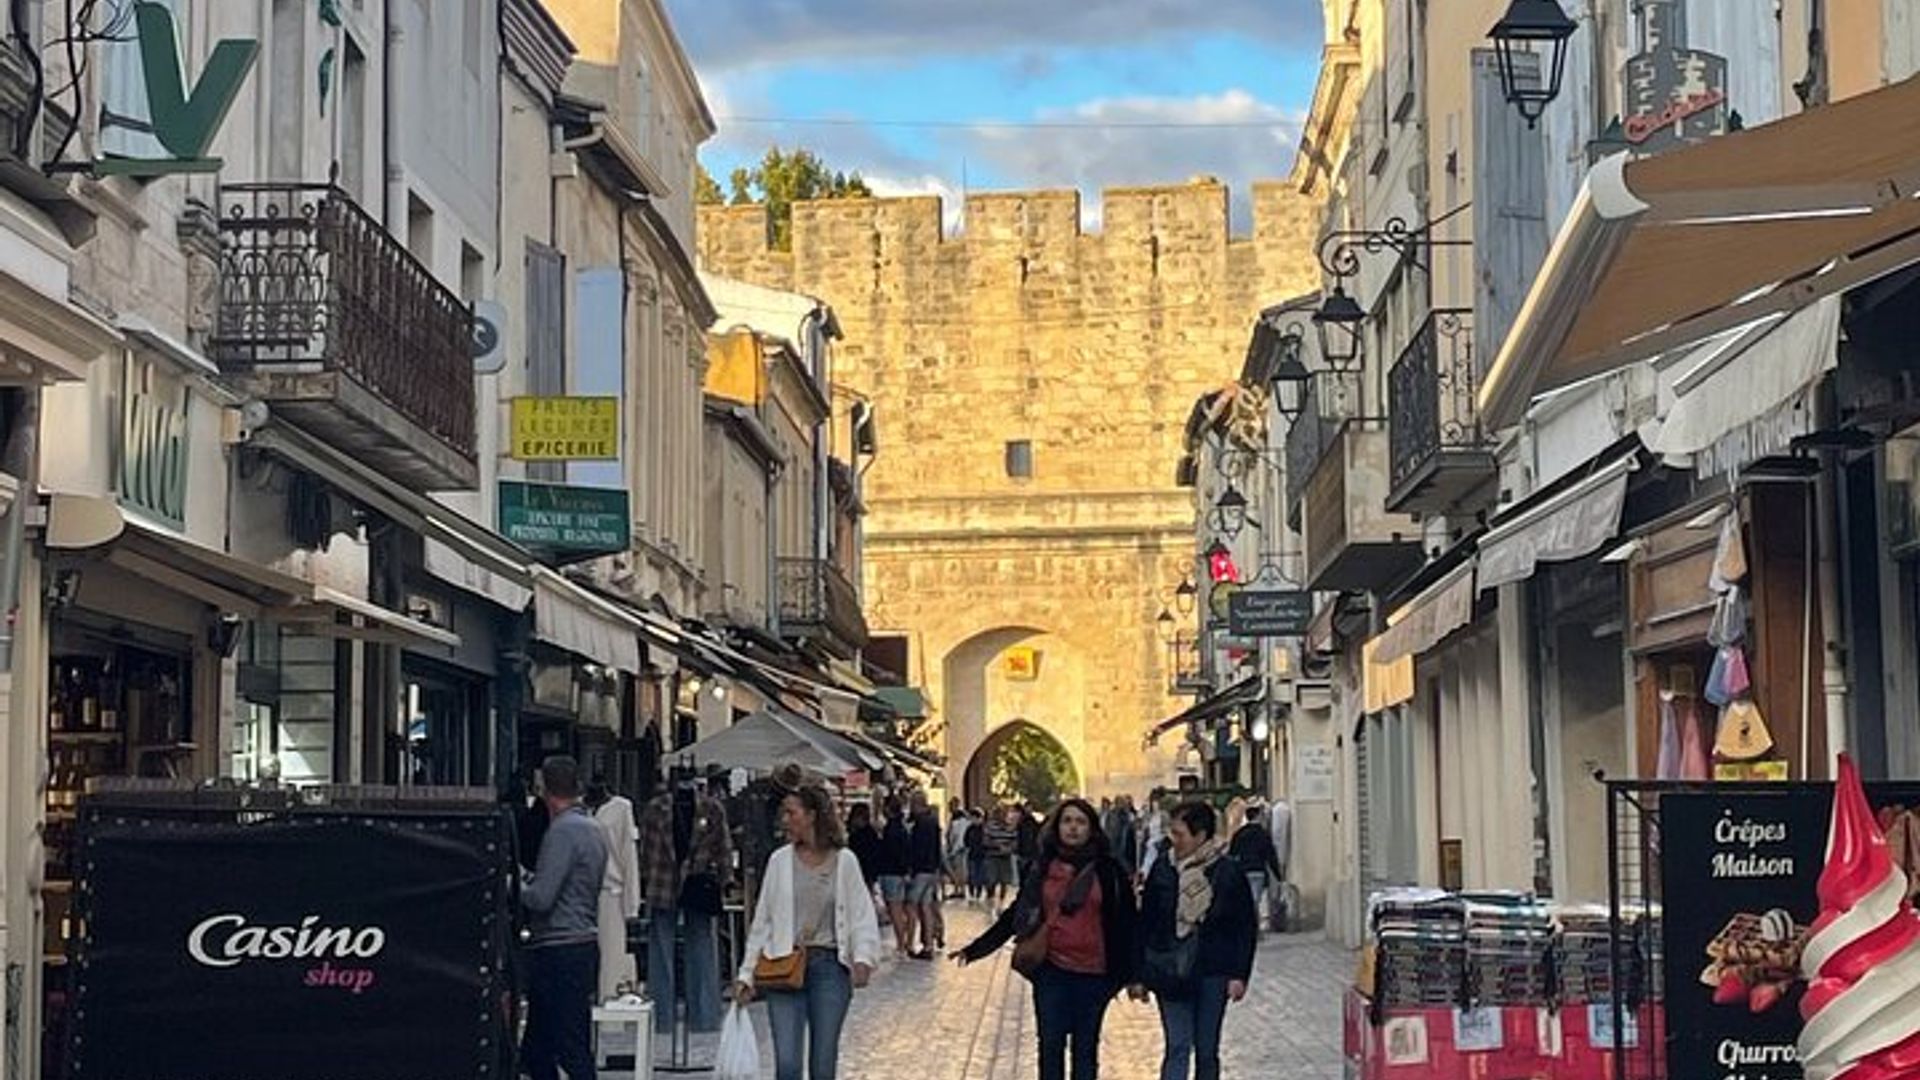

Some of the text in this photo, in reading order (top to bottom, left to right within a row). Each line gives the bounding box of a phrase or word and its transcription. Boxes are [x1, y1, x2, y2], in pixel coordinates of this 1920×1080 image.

[522, 441, 608, 456] EPICERIE
[1711, 853, 1795, 878] Maison
[188, 914, 385, 966] Casino
[303, 961, 375, 994] shop
